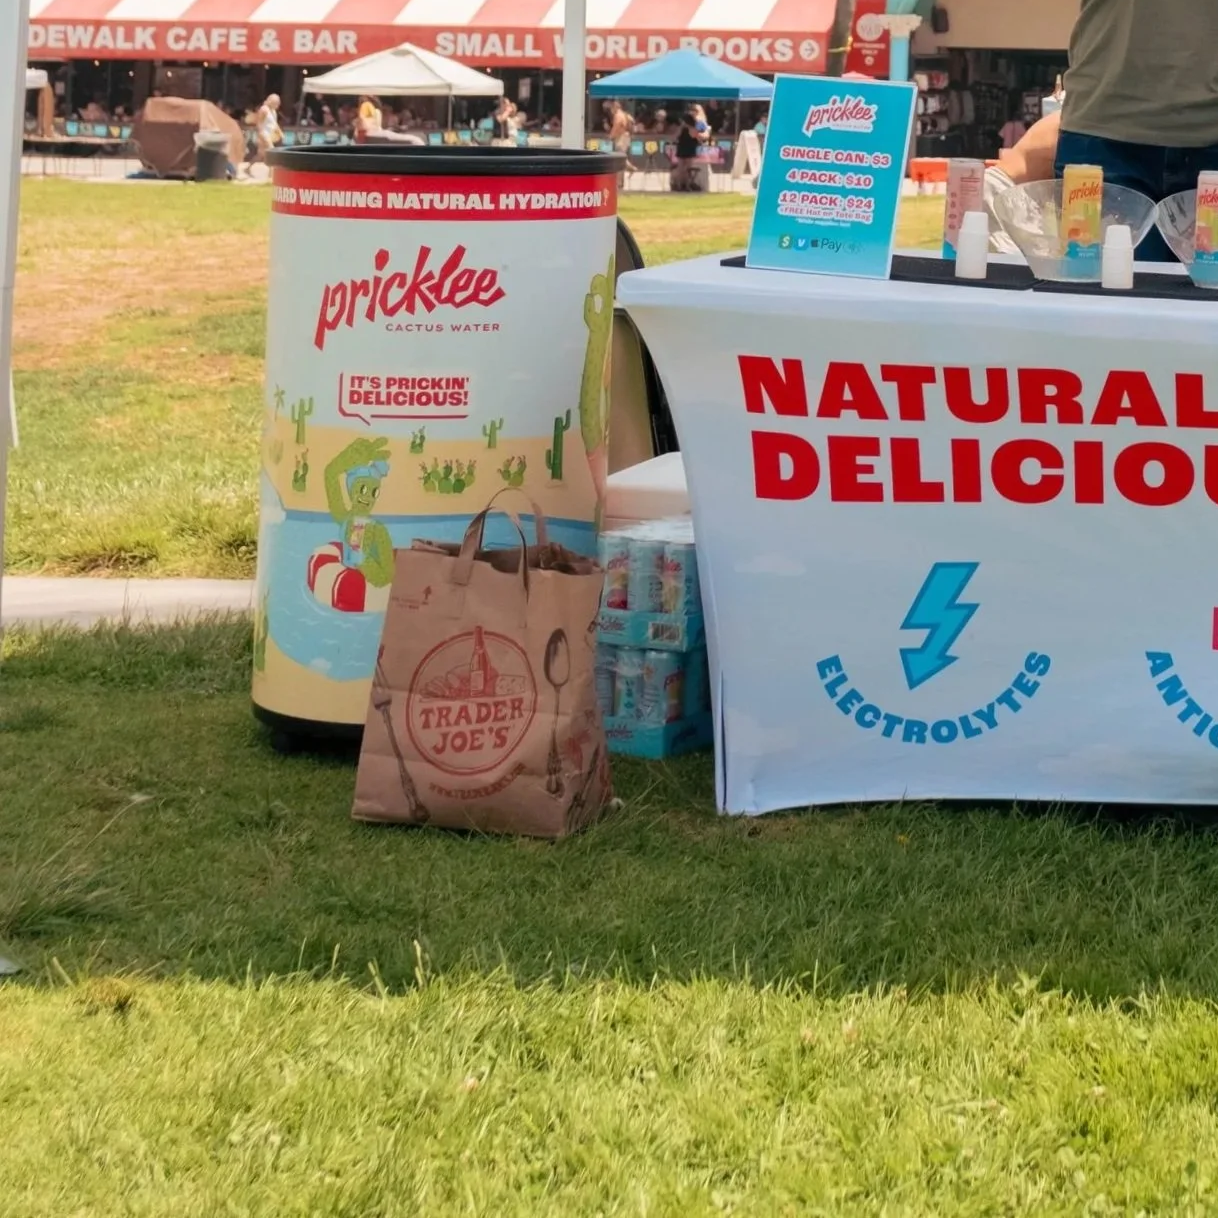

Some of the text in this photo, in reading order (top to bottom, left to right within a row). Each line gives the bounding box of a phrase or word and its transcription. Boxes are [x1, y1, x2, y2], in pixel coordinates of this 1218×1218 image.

[28, 25, 358, 54] DEWALK CAFE & BAR
[435, 32, 543, 58] SMALL
[805, 98, 874, 133] pricklee
[782, 147, 890, 166] SINGLE CAN: $3
[788, 171, 873, 187] 4 PACK: $10
[299, 188, 383, 209] WINNING
[386, 193, 495, 210] NATURAL
[500, 190, 602, 210] HYDRATION
[780, 192, 873, 209] 12 PACK: $24
[820, 238, 842, 252] Pay
[314, 245, 506, 351] pricklee
[385, 323, 500, 332] CACTUS WATER
[350, 376, 470, 391] IT'S PRICKIN'
[349, 390, 469, 406] DELICIOUS!
[816, 651, 1052, 745] ELECTROLYTES
[420, 697, 525, 730] TRADER
[432, 726, 511, 755] JOE'S
